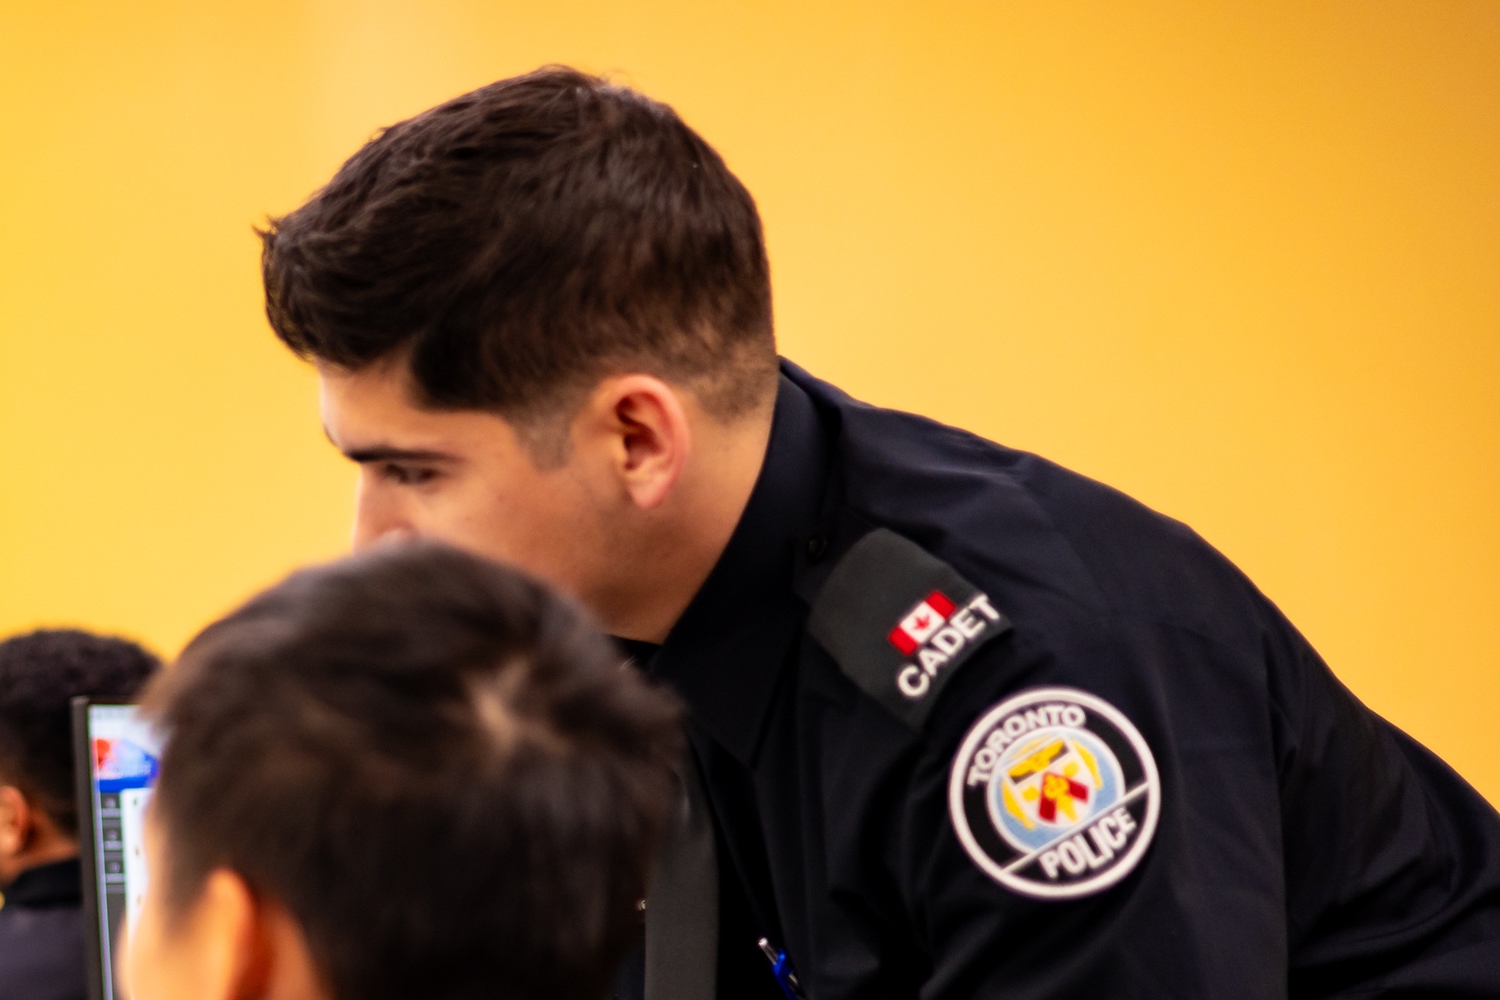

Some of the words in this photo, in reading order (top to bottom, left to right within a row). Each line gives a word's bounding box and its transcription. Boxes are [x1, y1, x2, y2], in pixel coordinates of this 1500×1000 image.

[897, 593, 1000, 697] CADET
[967, 705, 1086, 787] TORONTO
[1040, 806, 1137, 879] POLICE
